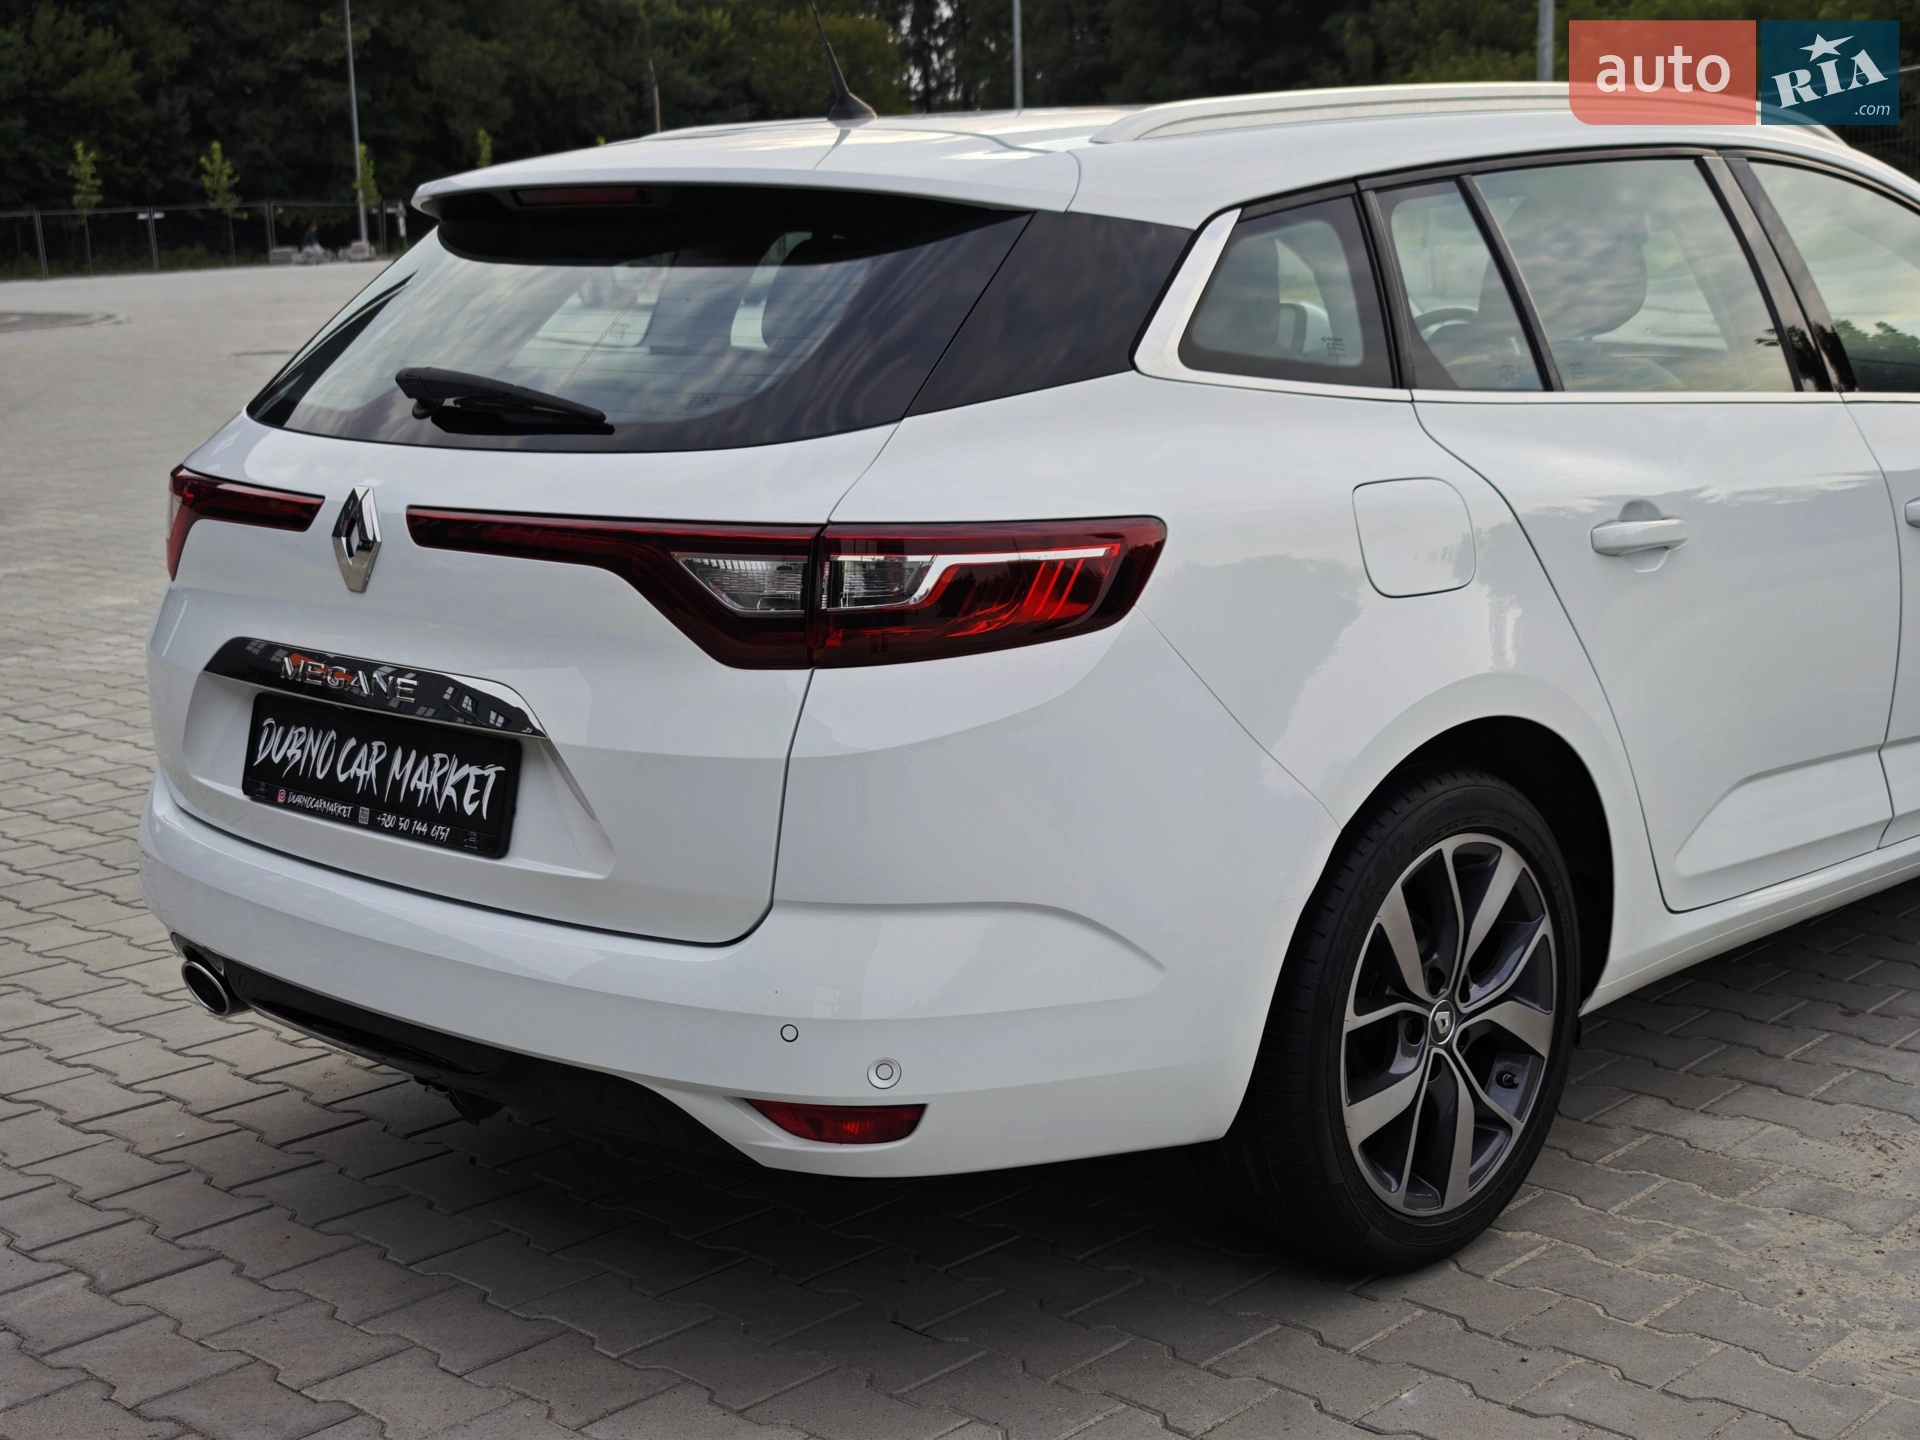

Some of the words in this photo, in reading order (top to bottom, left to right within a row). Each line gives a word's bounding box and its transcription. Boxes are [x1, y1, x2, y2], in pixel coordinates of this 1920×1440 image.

[253, 717, 337, 780] DUBNO
[337, 736, 387, 795] CAR
[384, 745, 507, 821] MARKET
[287, 791, 354, 819] DUBNOCARMARKET
[376, 812, 397, 829] +380
[398, 816, 411, 831] 50
[411, 819, 428, 836] 144
